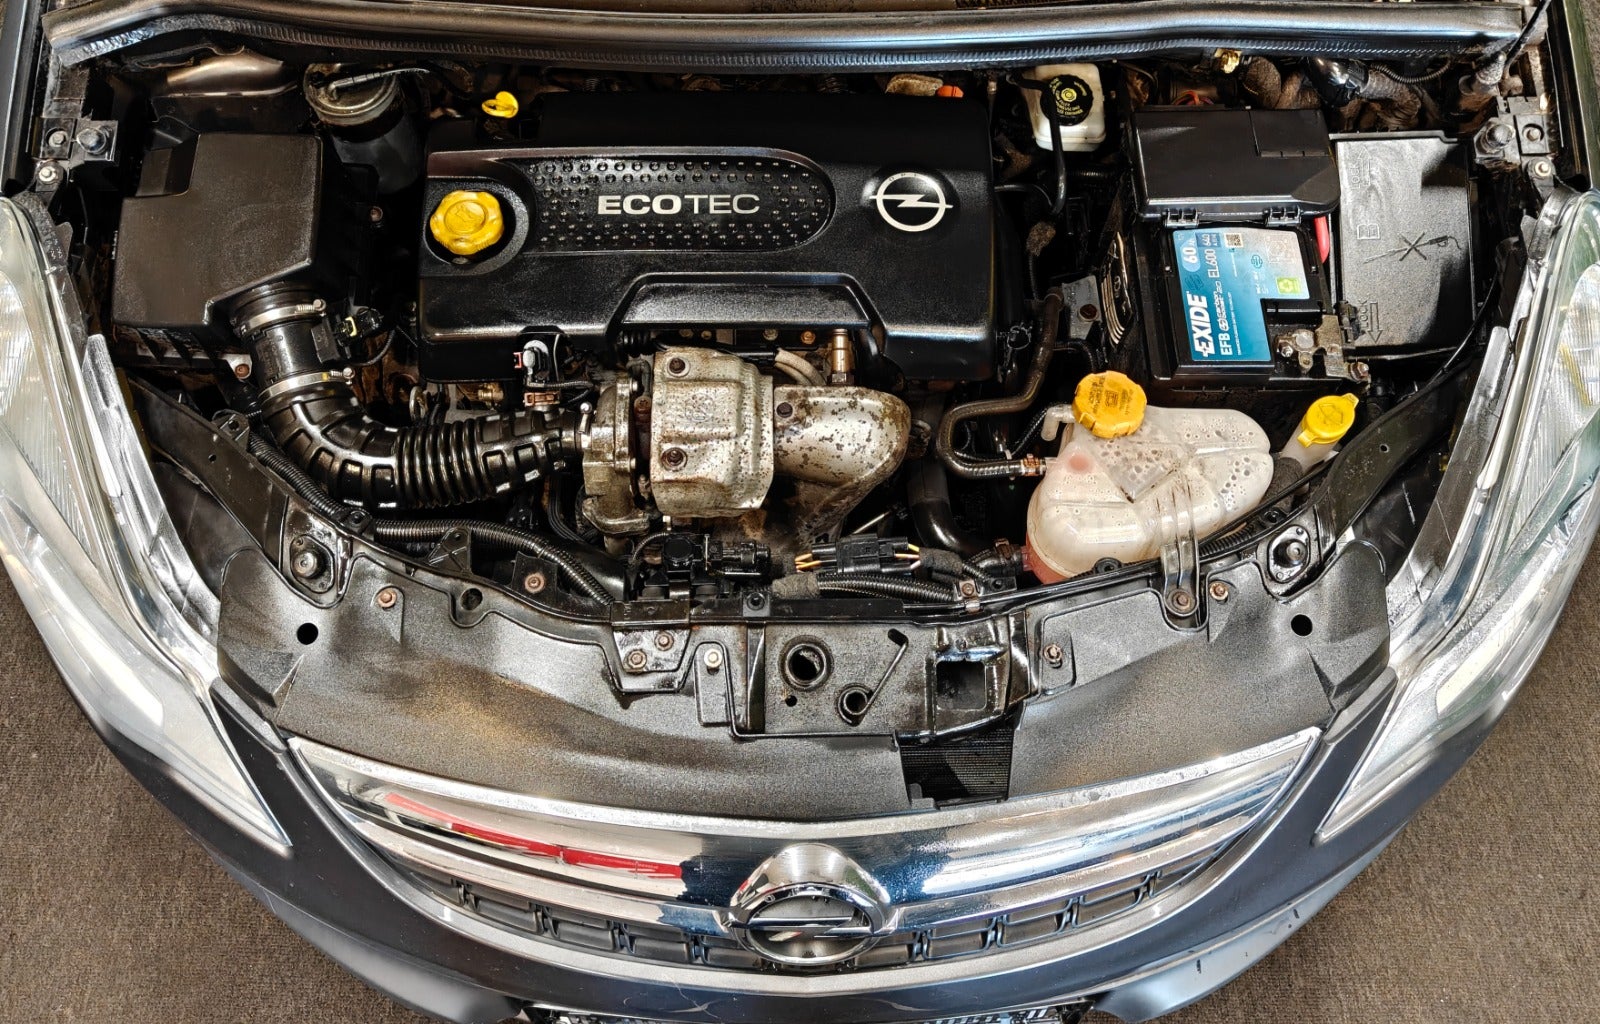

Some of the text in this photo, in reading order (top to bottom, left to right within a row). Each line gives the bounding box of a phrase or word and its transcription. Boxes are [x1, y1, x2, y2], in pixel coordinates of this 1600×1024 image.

[597, 193, 760, 215] ECOTEC
[1182, 246, 1198, 264] 60
[1204, 248, 1220, 278] EL600
[1186, 293, 1215, 357] EXIDE
[1358, 299, 1369, 328] LOCK
[1218, 332, 1233, 355] EFB
